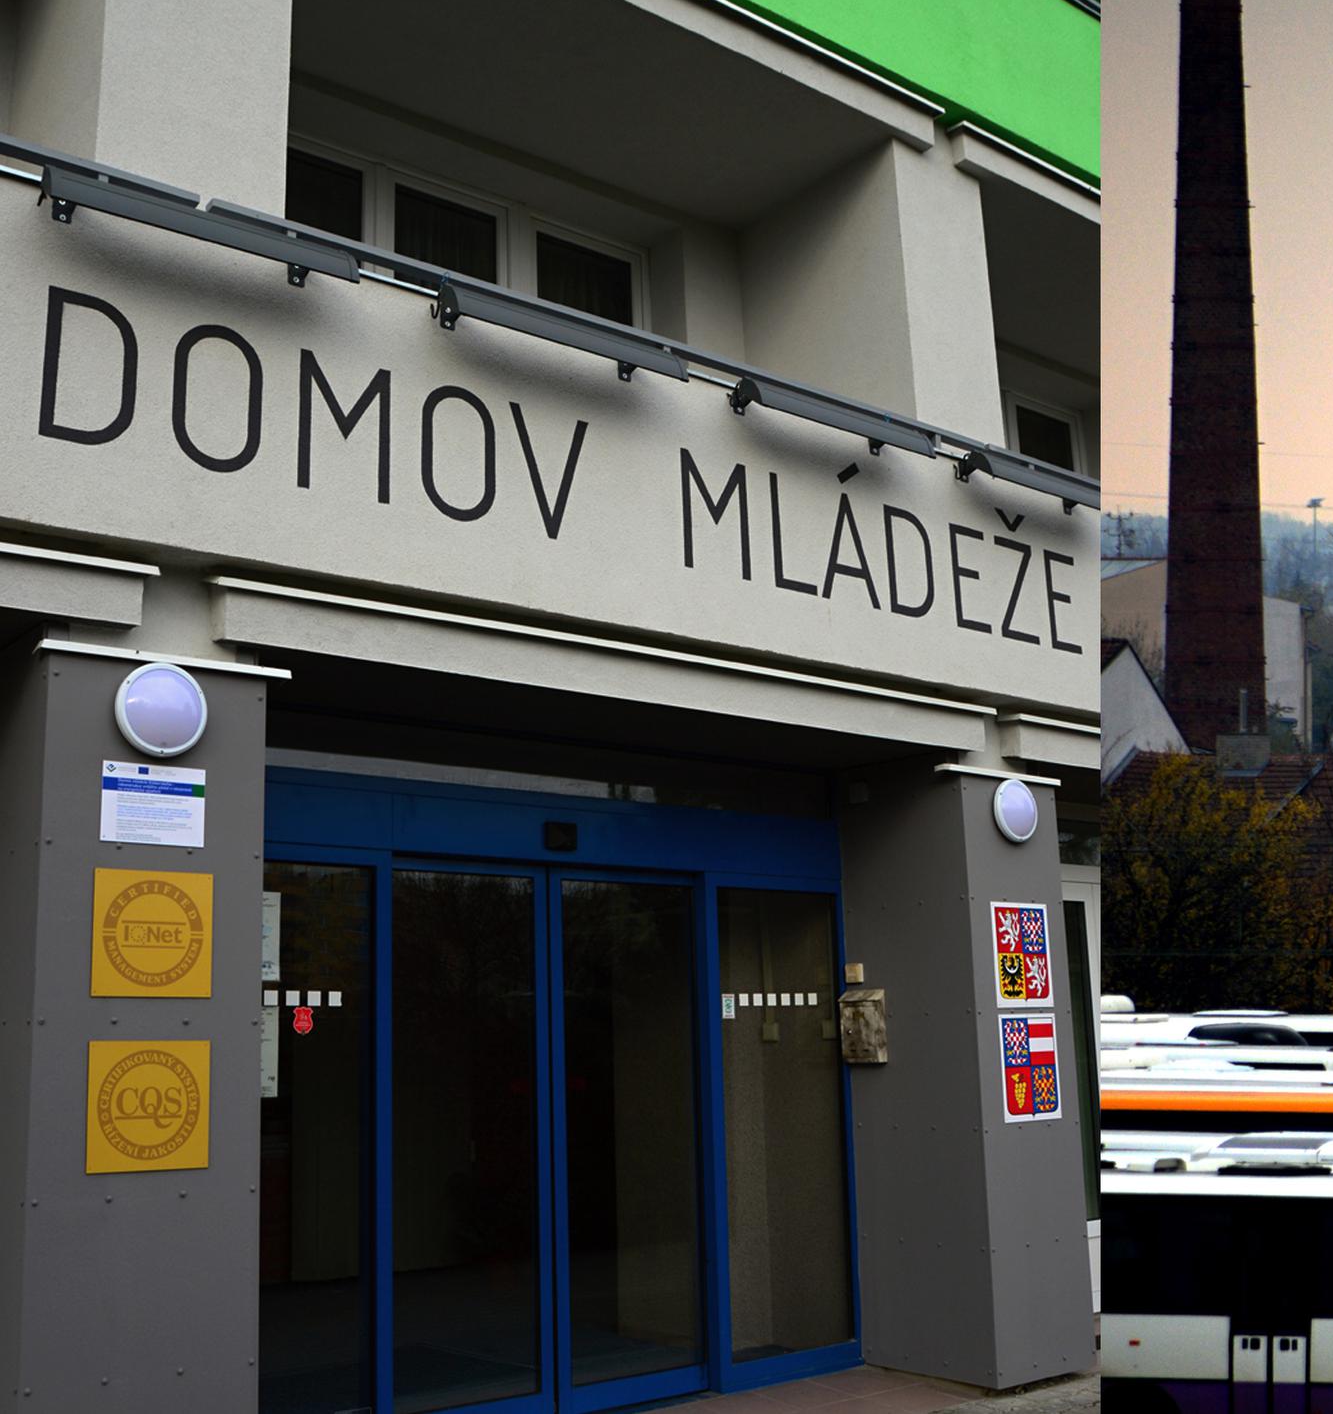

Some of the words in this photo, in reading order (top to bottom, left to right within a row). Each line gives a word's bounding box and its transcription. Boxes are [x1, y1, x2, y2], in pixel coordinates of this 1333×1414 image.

[38, 284, 589, 539] DOMOV
[680, 462, 1083, 655] MLÁDEŽE
[109, 882, 198, 921] CERTIFIED
[123, 923, 183, 946] IQNet
[116, 1086, 183, 1130] CQS
